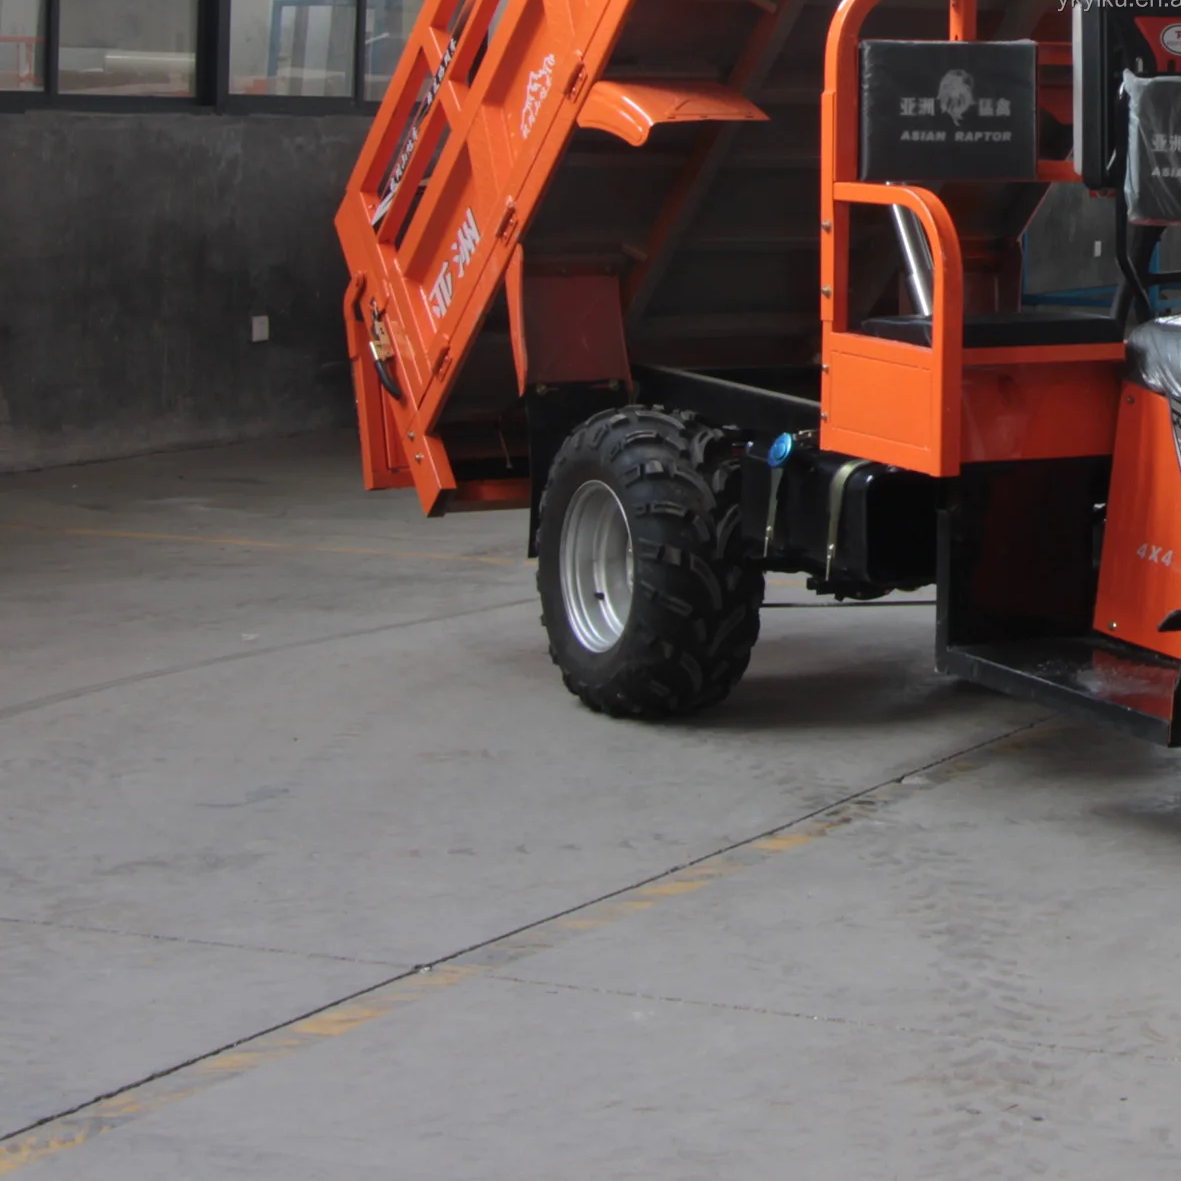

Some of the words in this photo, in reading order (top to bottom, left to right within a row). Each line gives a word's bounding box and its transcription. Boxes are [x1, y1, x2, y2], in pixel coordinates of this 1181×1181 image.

[900, 97, 935, 117] 亚洲
[978, 97, 1011, 117] 猛禽
[900, 130, 946, 142] ASIAN
[954, 130, 1012, 142] RAPTOR
[1136, 542, 1174, 567] 4X4
